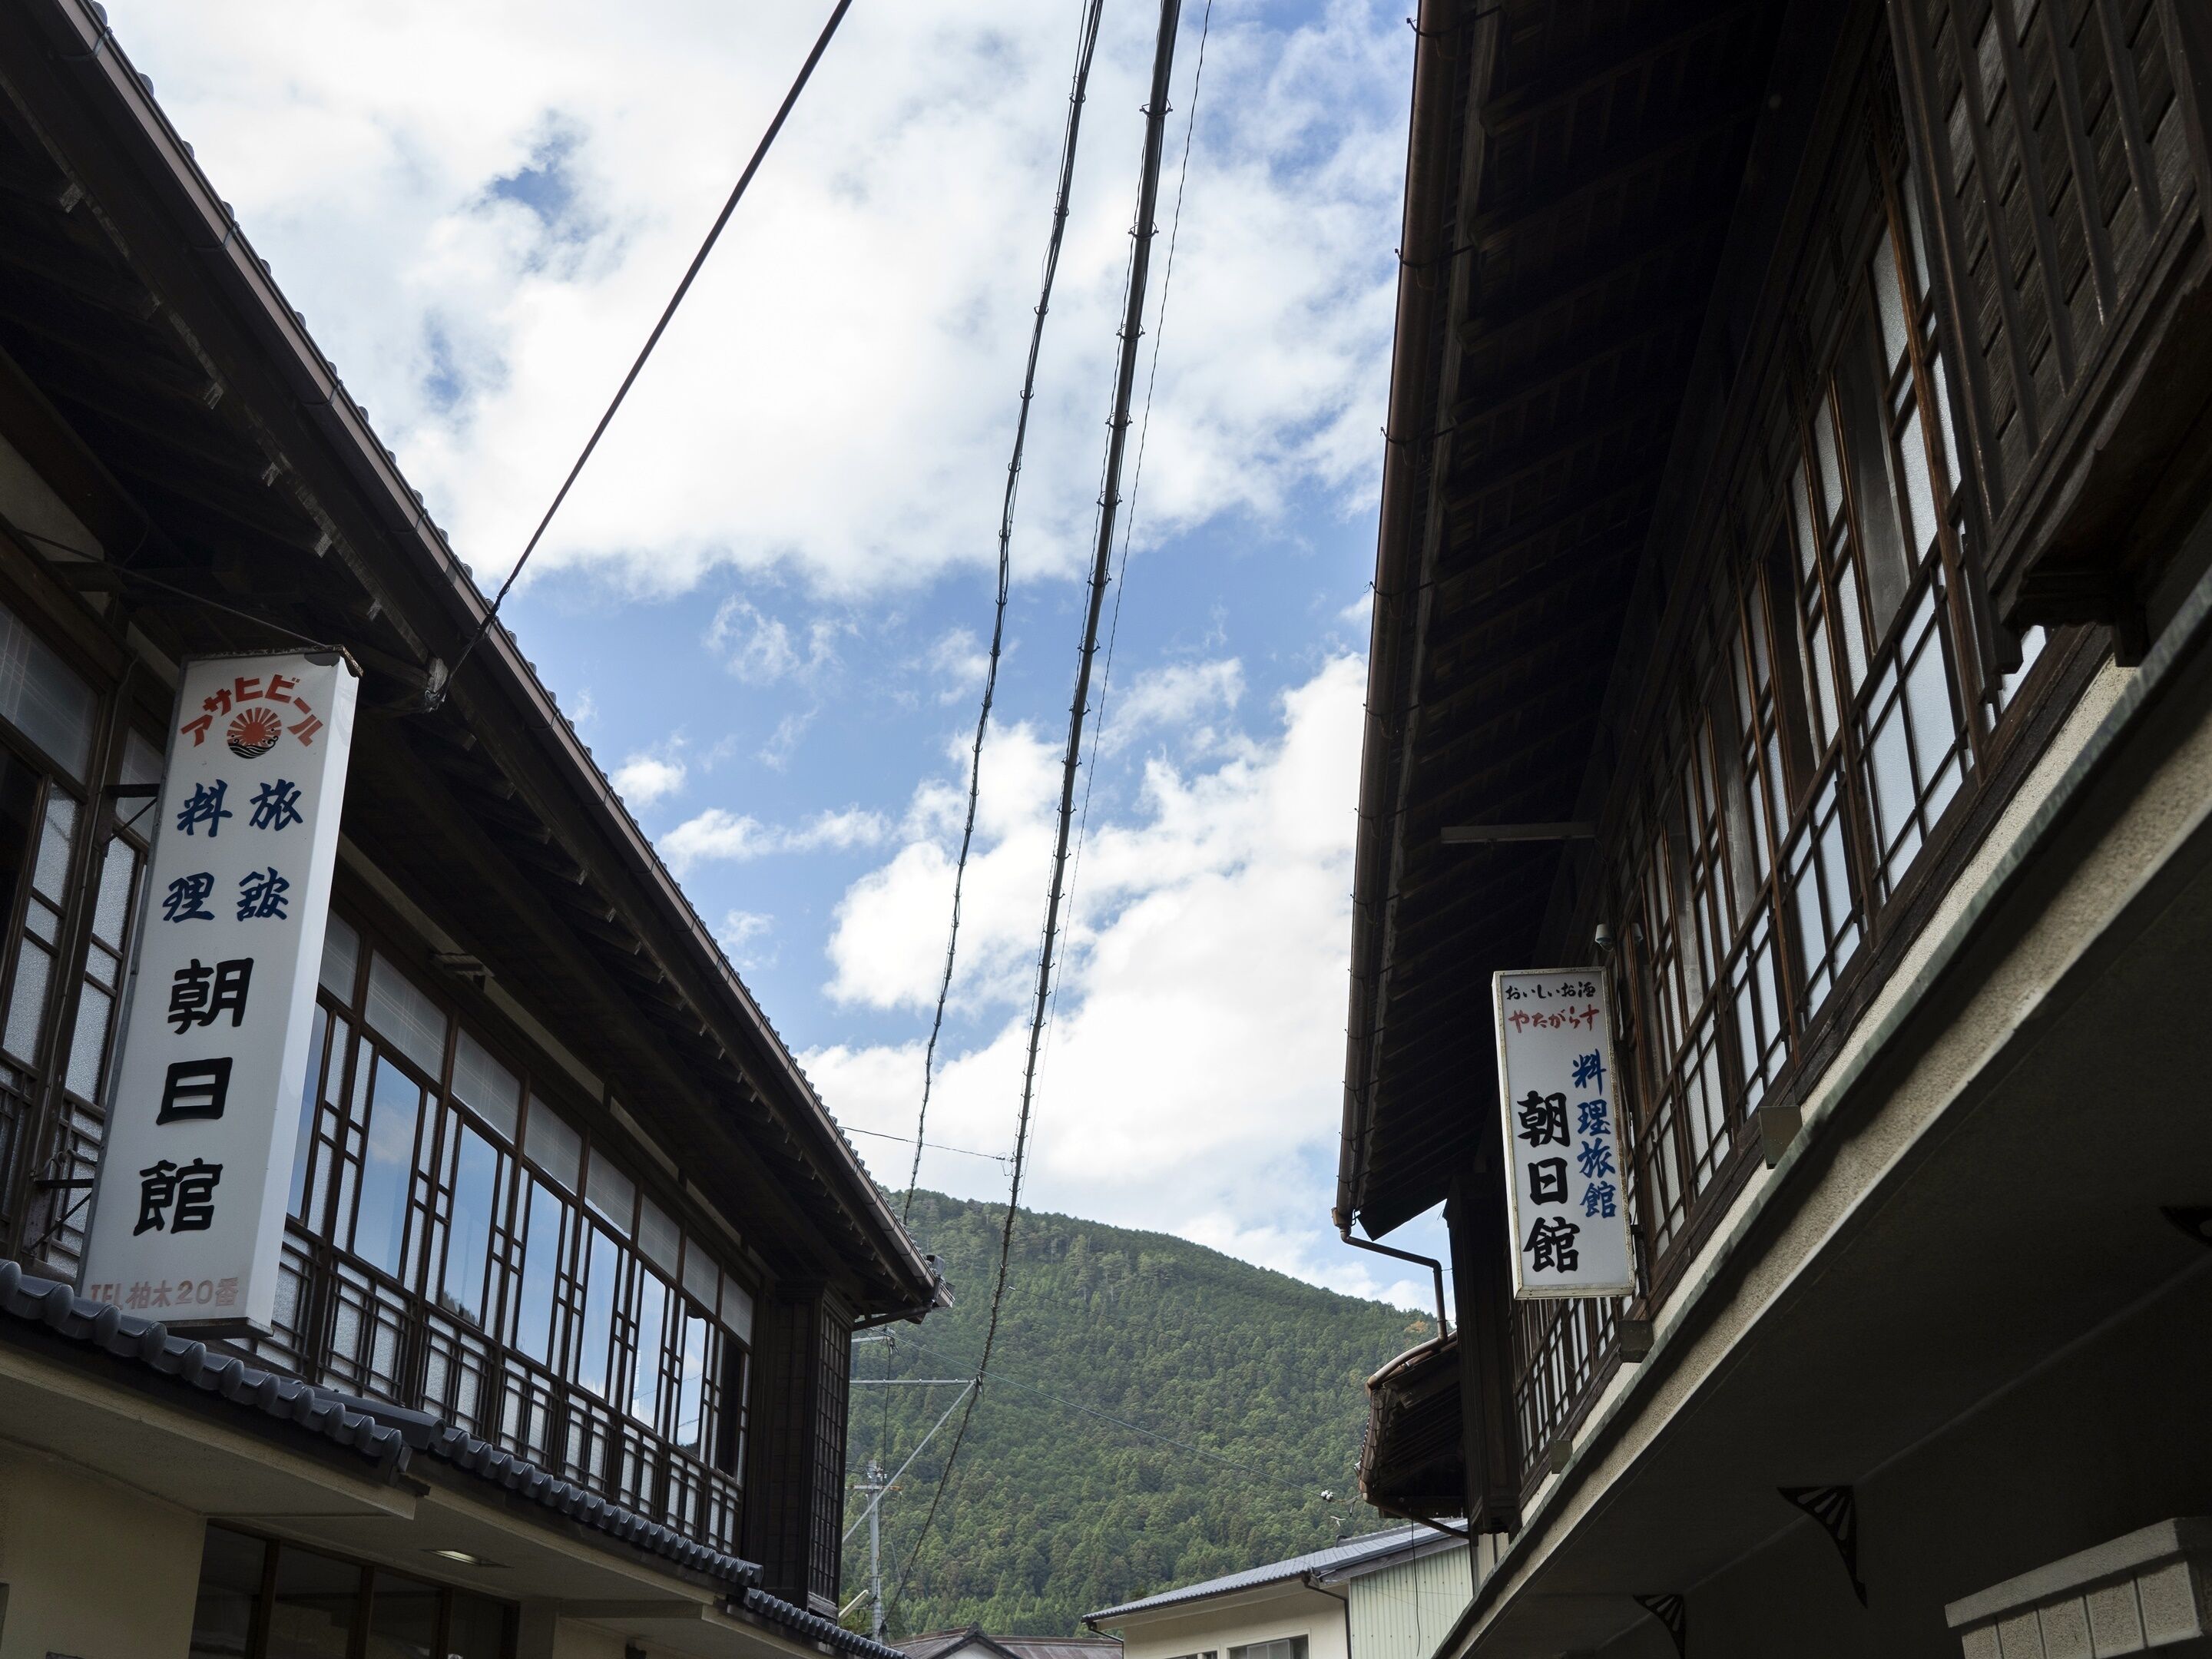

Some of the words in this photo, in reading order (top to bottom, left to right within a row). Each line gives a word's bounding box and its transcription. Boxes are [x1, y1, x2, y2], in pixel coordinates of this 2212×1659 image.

[180, 674, 323, 747] アサヒビール
[162, 779, 233, 924] 料理
[1505, 982, 1596, 1001] おいしいお酒
[1508, 1003, 1600, 1034] やたがらす
[133, 957, 254, 1237] 朝日館
[1571, 1048, 1616, 1218] 料理旅館
[1516, 1090, 1581, 1273] 朝日館
